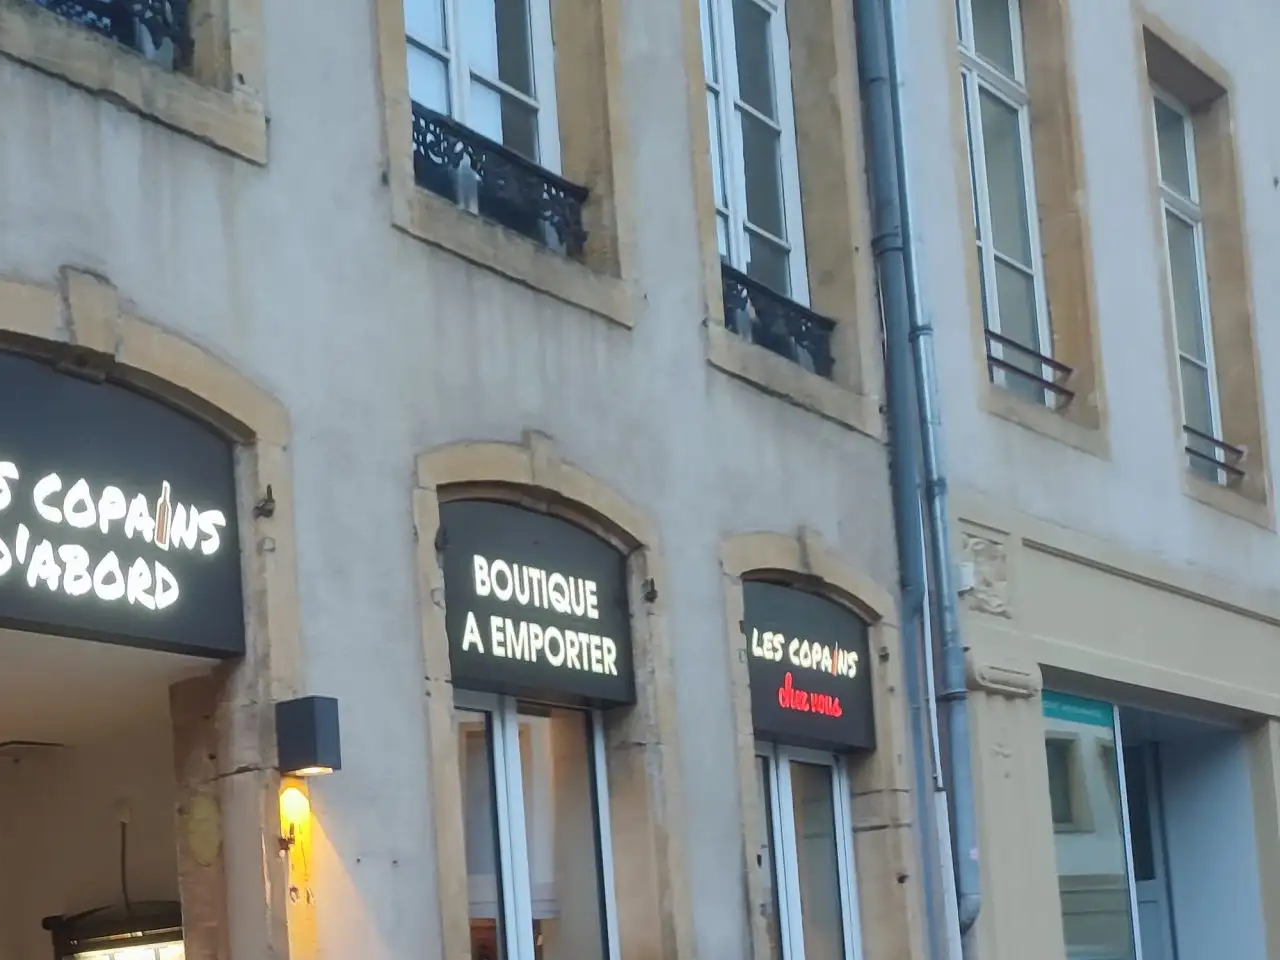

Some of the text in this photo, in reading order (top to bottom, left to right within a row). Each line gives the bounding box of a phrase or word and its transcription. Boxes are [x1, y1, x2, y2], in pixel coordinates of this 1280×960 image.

[33, 472, 226, 556] COPAINS
[473, 554, 600, 620] BOUTIQUE
[462, 611, 618, 676] A EMPORTER
[751, 627, 859, 679] LES COPAINS
